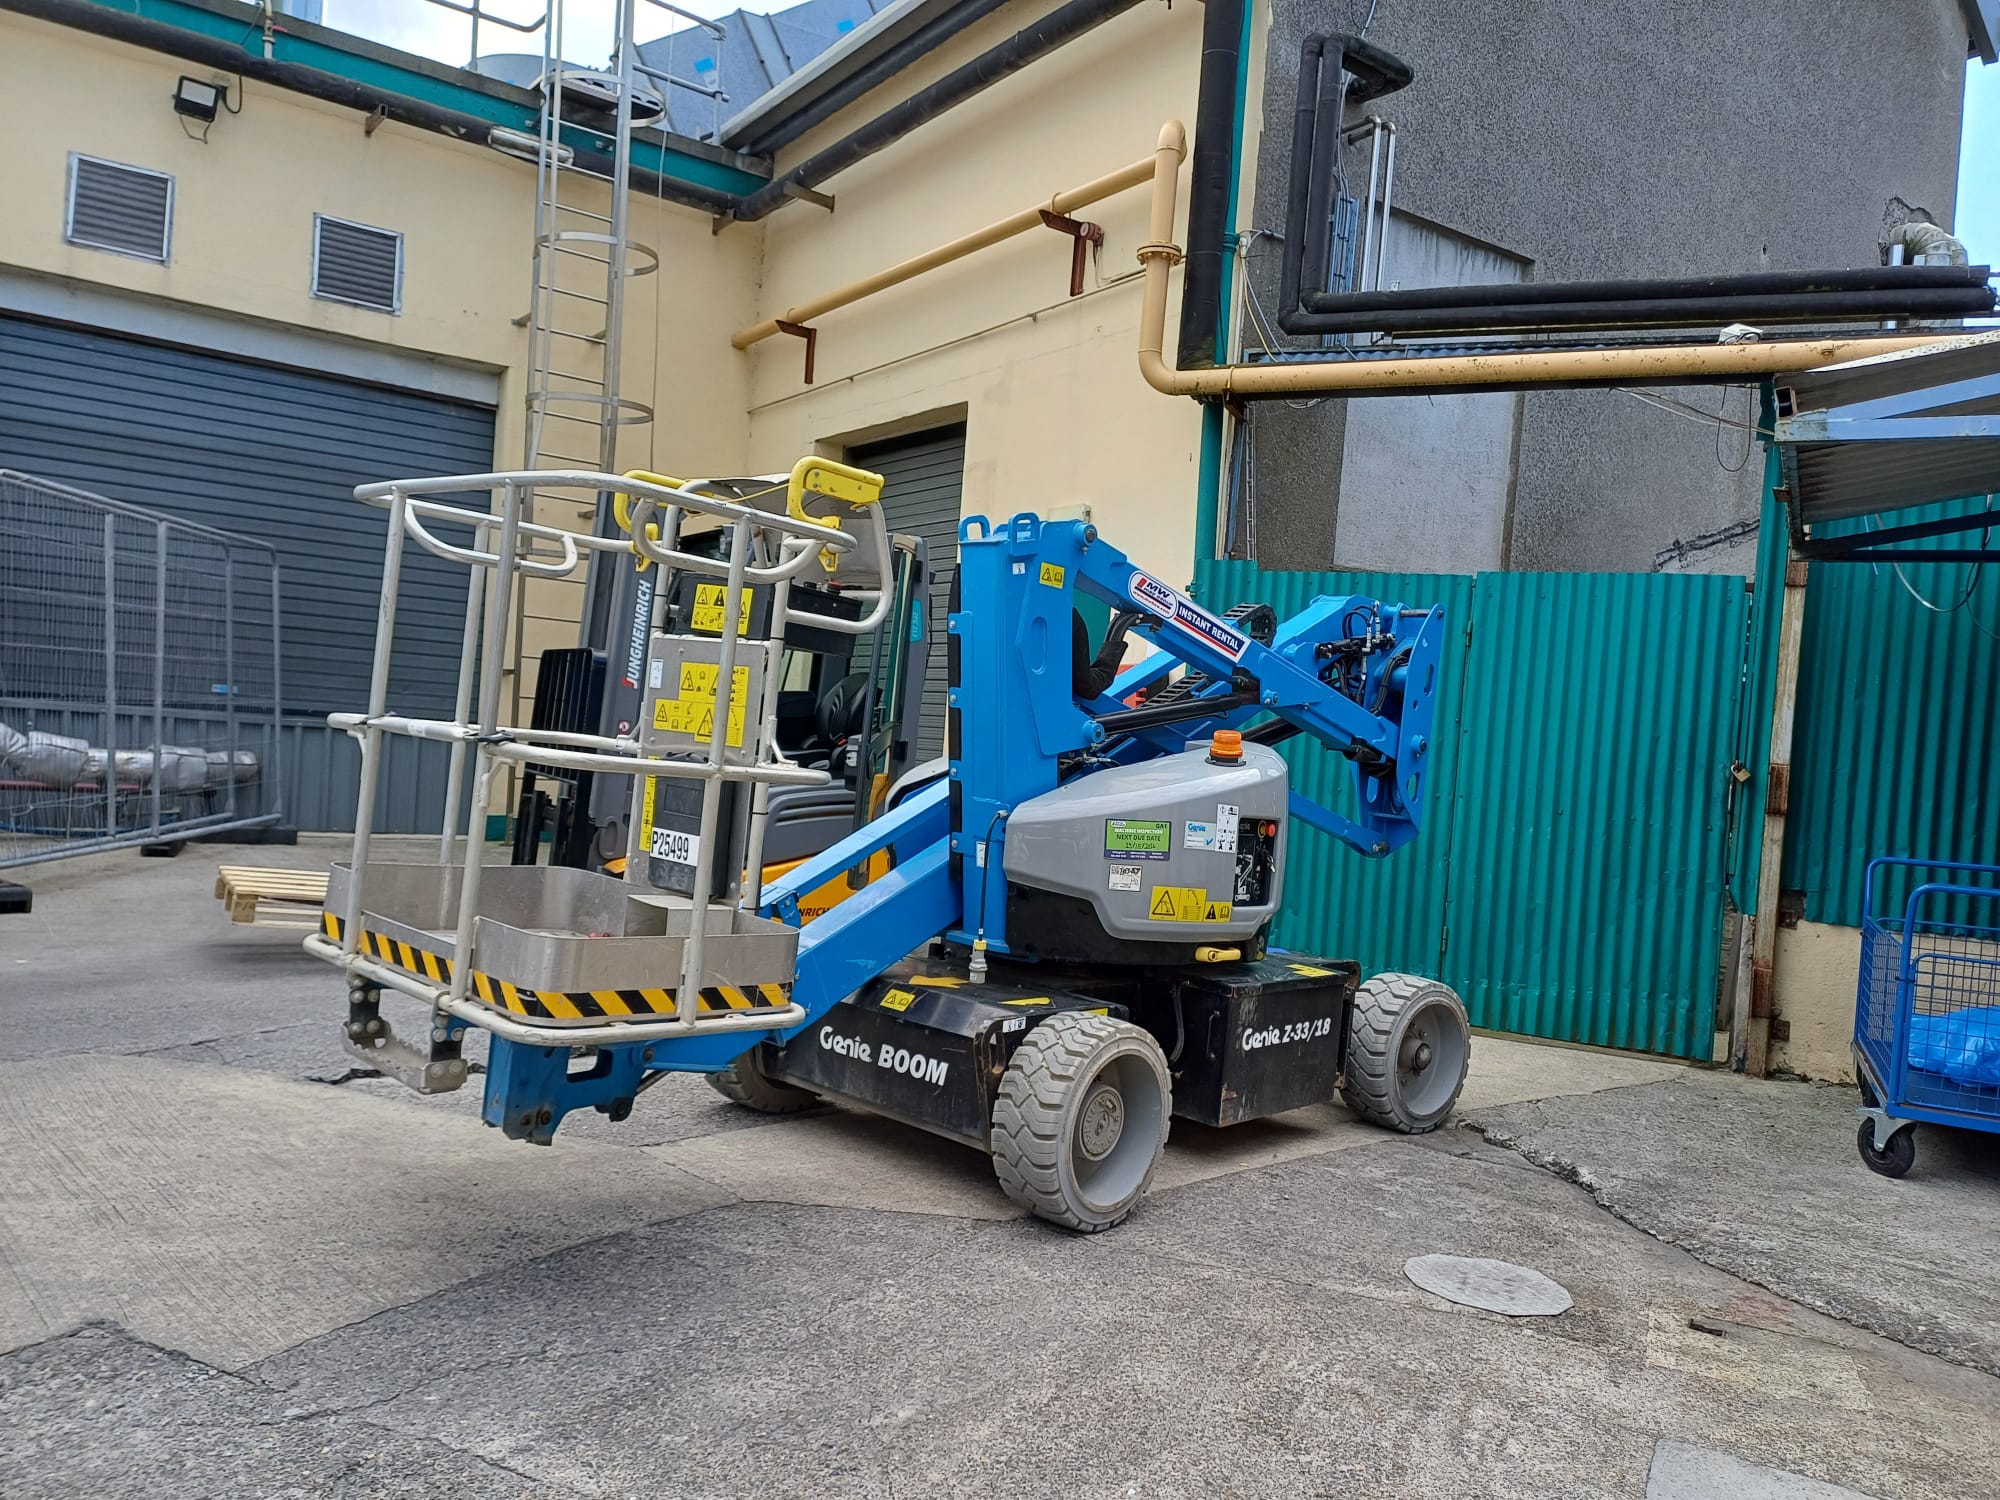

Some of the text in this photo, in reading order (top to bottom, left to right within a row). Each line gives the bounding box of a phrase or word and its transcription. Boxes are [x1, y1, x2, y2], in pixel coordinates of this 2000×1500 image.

[622, 579, 651, 689] JUNGHEINRICH
[1179, 606, 1239, 650] INSTANT RENTAL
[1146, 834, 1161, 842] DATE
[1187, 823, 1206, 832] Genie
[651, 830, 689, 861] P25499
[1242, 1017, 1331, 1051] Genie Z-33/18
[820, 1025, 949, 1086] Genie BOOM
